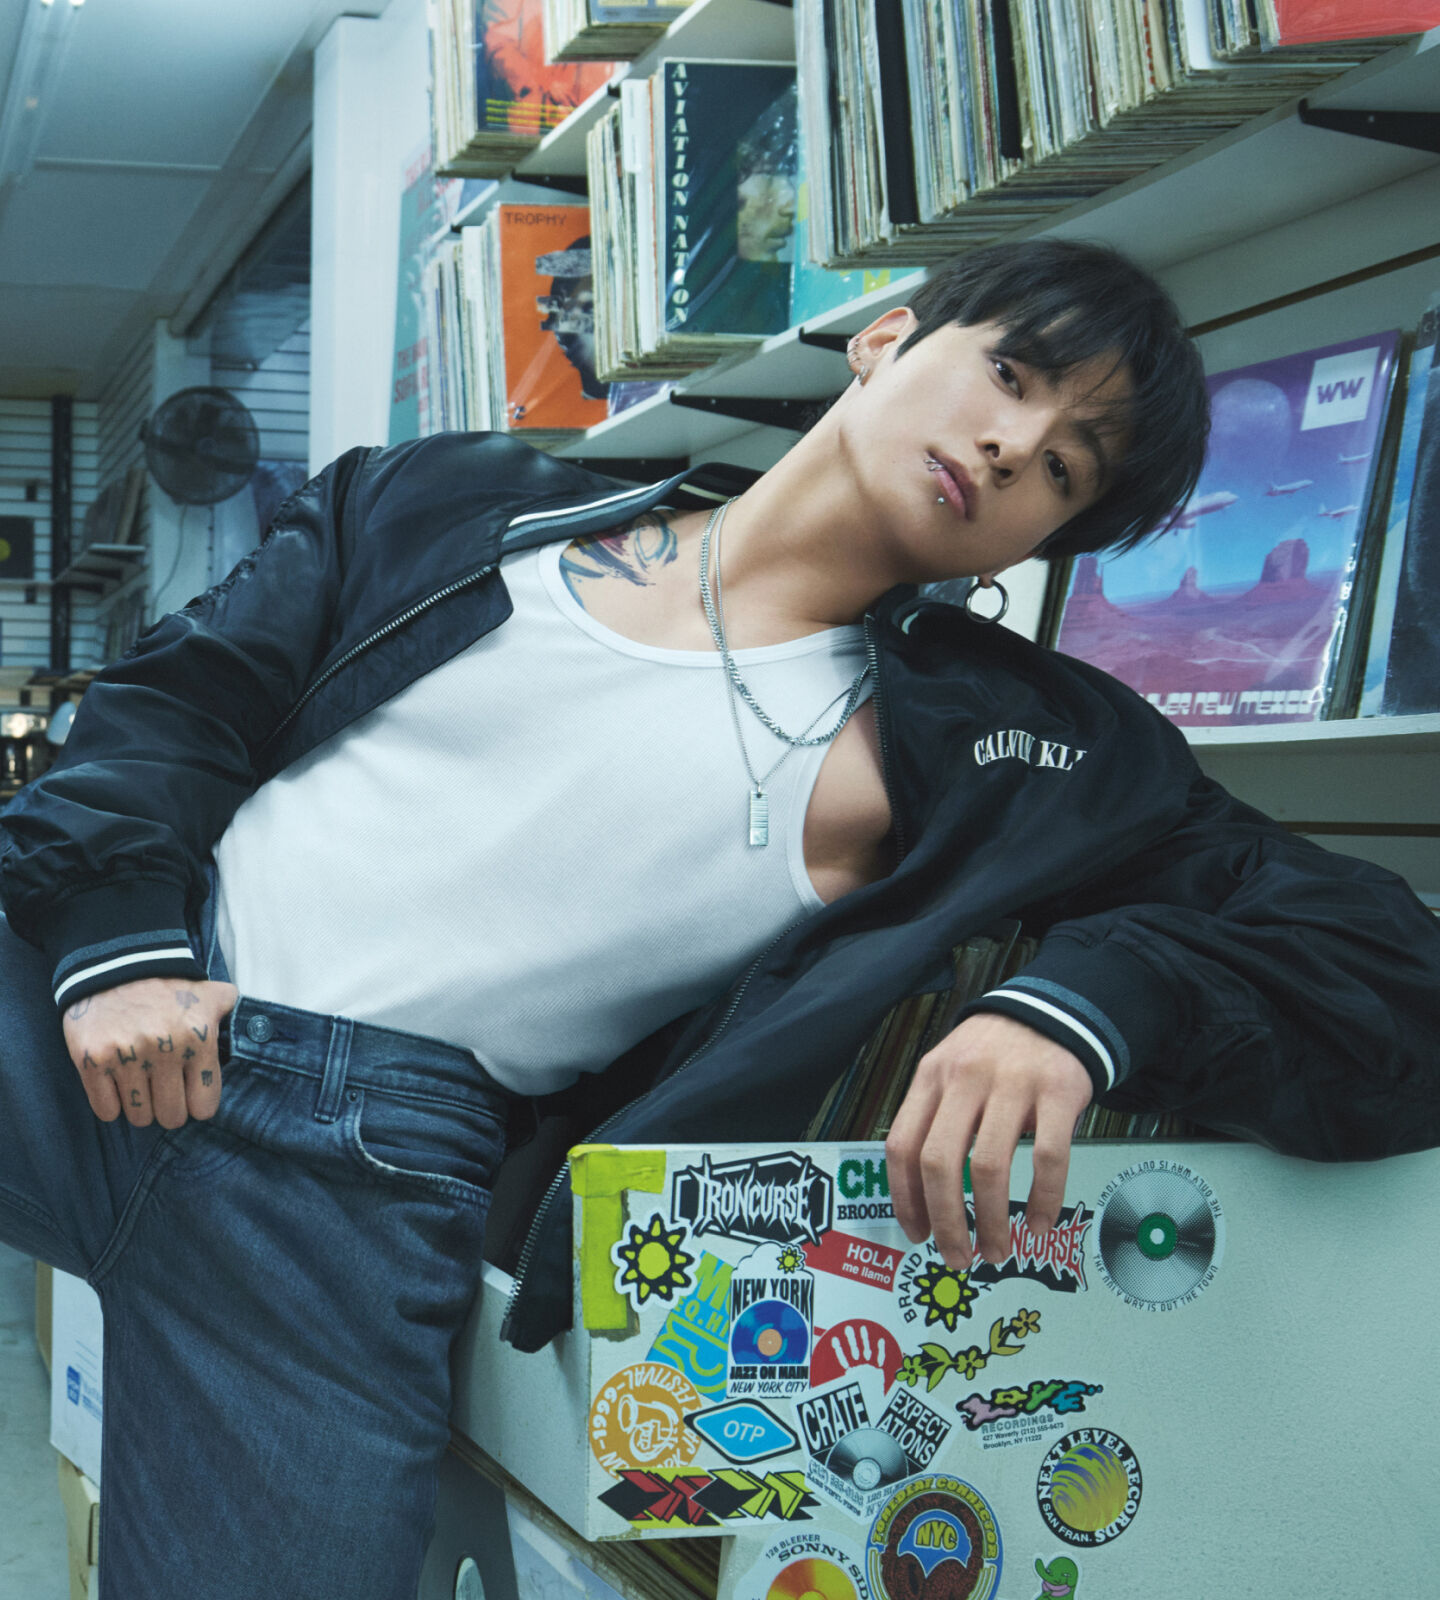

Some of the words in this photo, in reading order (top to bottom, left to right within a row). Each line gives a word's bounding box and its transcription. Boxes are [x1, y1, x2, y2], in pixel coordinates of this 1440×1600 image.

[671, 63, 689, 207] AVIATION
[504, 212, 567, 225] TROPHY
[671, 215, 689, 323] NATION
[1317, 377, 1366, 405] WW
[1193, 692, 1235, 715] NEW
[837, 1158, 892, 1200] CH
[1118, 1166, 1135, 1182] THE
[1138, 1160, 1155, 1173] OUT
[1160, 1160, 1169, 1170] IS
[1172, 1163, 1192, 1177] WAY
[1097, 1180, 1119, 1208] TOWN
[1193, 1175, 1213, 1198] ONLY
[687, 1156, 820, 1246] IRONCURSE
[1210, 1199, 1223, 1219] THE
[847, 1243, 894, 1271] HOLA
[842, 1262, 859, 1274] me
[861, 1268, 891, 1285] llamo
[898, 1252, 922, 1323] BRAND
[1093, 1254, 1104, 1273] THE
[1124, 1295, 1144, 1310] WAY
[1148, 1303, 1157, 1313] IS
[1161, 1301, 1178, 1312] OUT
[1180, 1290, 1198, 1305] THE
[1197, 1265, 1219, 1291] TOWN
[732, 1279, 766, 1322] NEW
[770, 1278, 810, 1322] YORK
[622, 1365, 697, 1405] FESTIVAL
[729, 1366, 757, 1380] JAZZ
[760, 1366, 776, 1380] ON
[779, 1366, 809, 1379] MAIN
[730, 1382, 755, 1394] NEW
[758, 1381, 782, 1393] YORK
[786, 1381, 808, 1393] CITY
[801, 1383, 870, 1451] CRATE
[889, 1388, 951, 1443] EXPECT
[981, 1413, 1055, 1435] RECORDINGS
[723, 1419, 766, 1443] OTP
[875, 1412, 936, 1465] ATIONS
[982, 1433, 994, 1442] 427
[994, 1430, 1019, 1441] Waverly
[1020, 1426, 1036, 1439] (212)
[983, 1440, 1014, 1450] Brooklyn,
[1014, 1436, 1023, 1444] NY
[1067, 1429, 1126, 1458] LEVEL
[1038, 1442, 1067, 1501] NEXT
[1094, 1456, 1141, 1543] RECORDS
[936, 1476, 998, 1559] CONNECTOR
[1042, 1502, 1060, 1528] SAN
[1058, 1525, 1092, 1543] FRAN.
[779, 1534, 820, 1549] BLEEKER
[916, 1520, 957, 1550] NYC
[778, 1543, 850, 1563] SONNY
